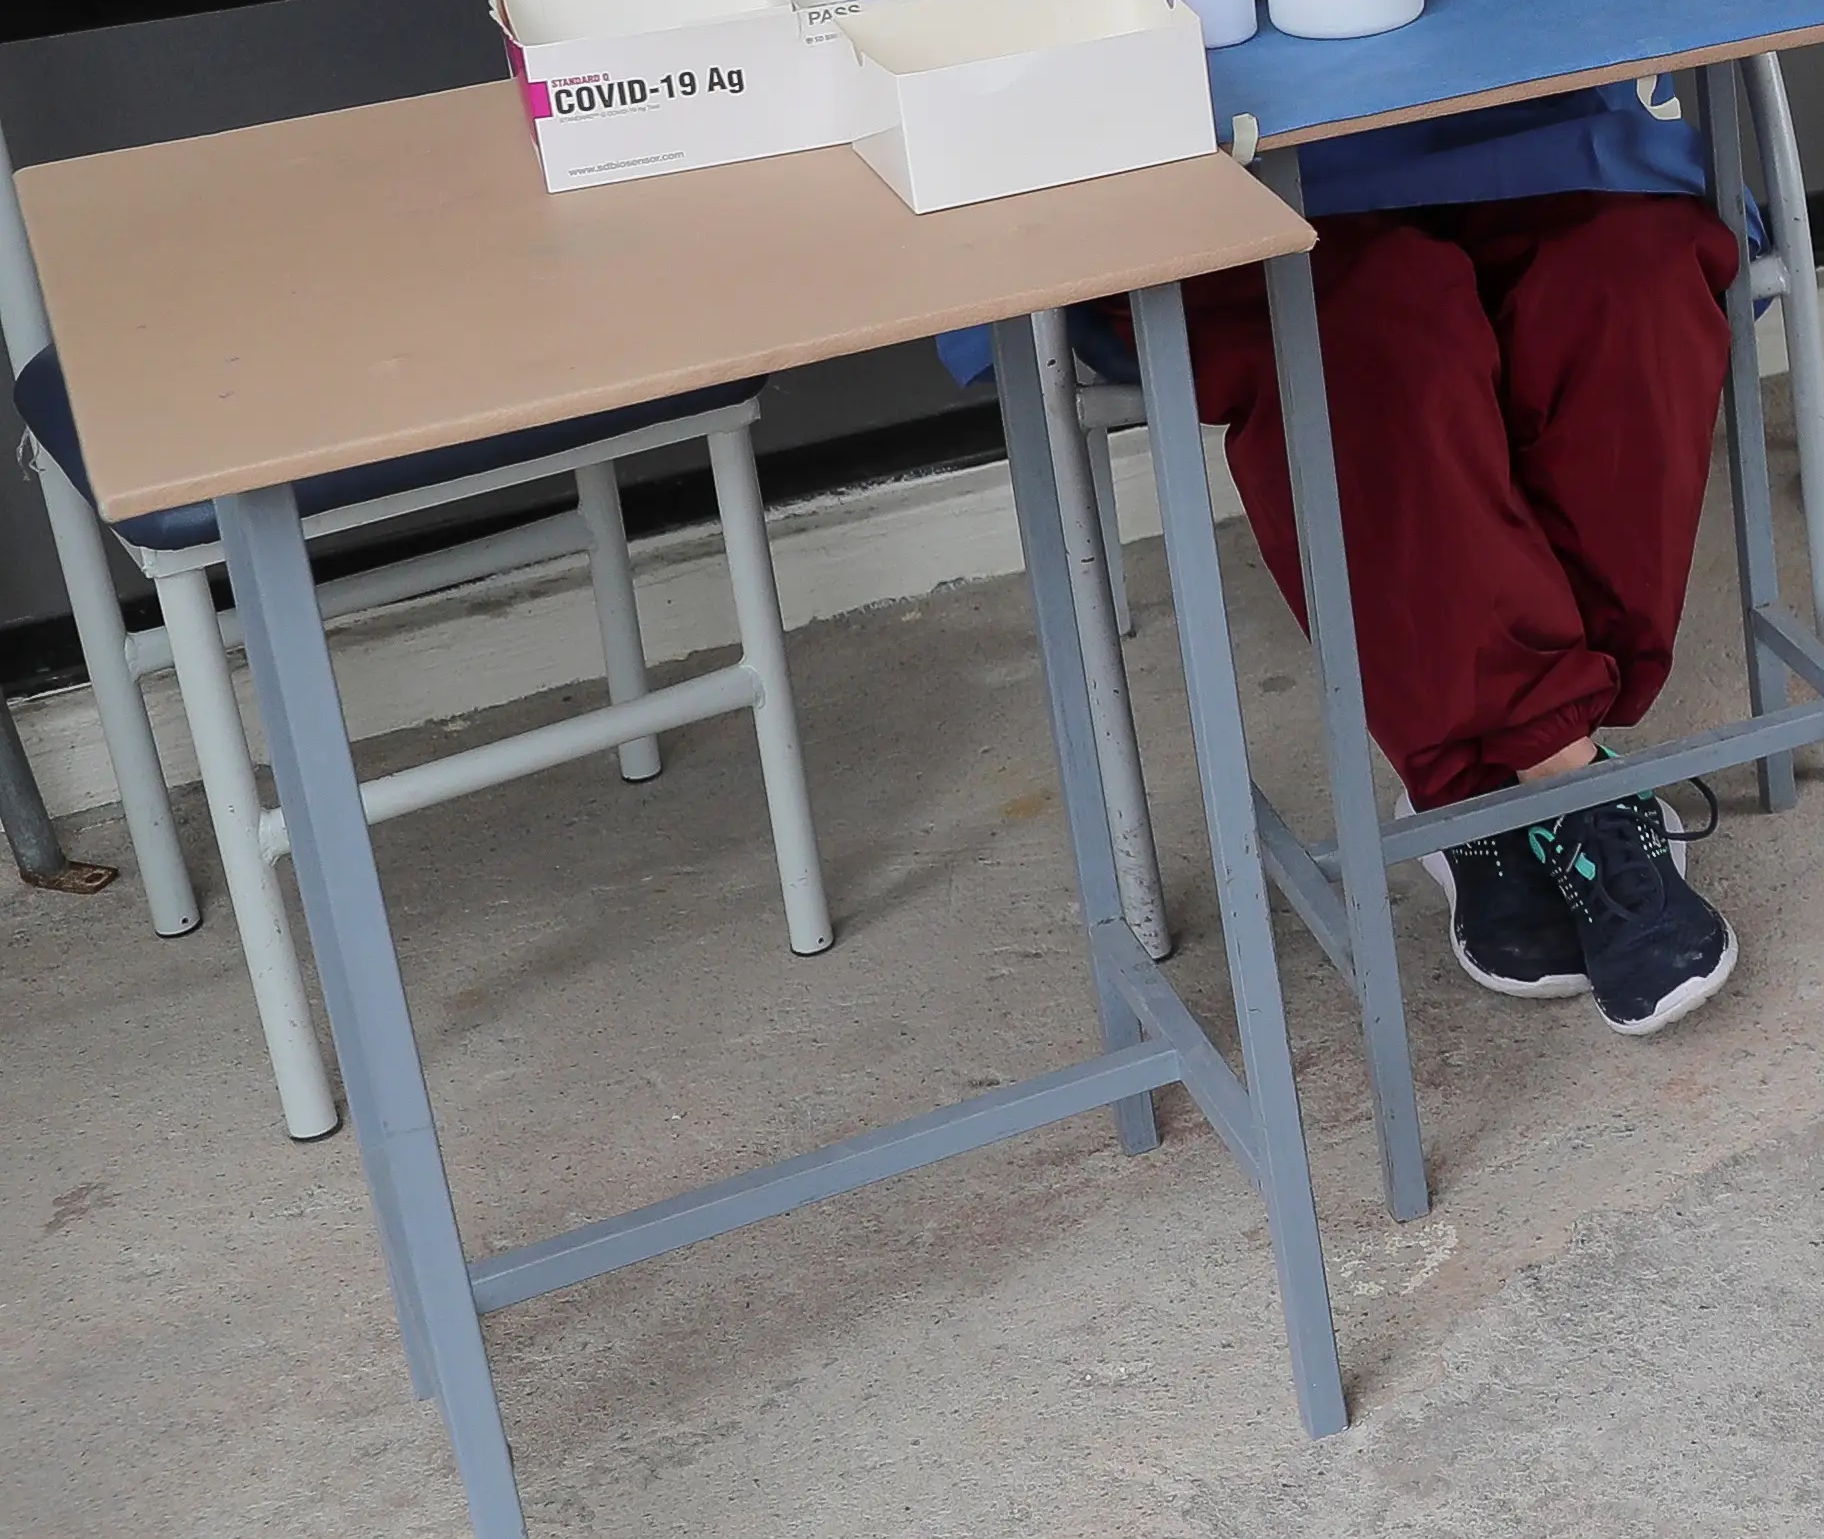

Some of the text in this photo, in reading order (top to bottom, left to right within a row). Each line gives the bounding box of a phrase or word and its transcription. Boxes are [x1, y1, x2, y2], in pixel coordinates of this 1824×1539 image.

[551, 73, 610, 88] STANDARD Q
[555, 66, 745, 115] COVID-19 Ag
[568, 150, 685, 177] www.sdbiosensor.com
